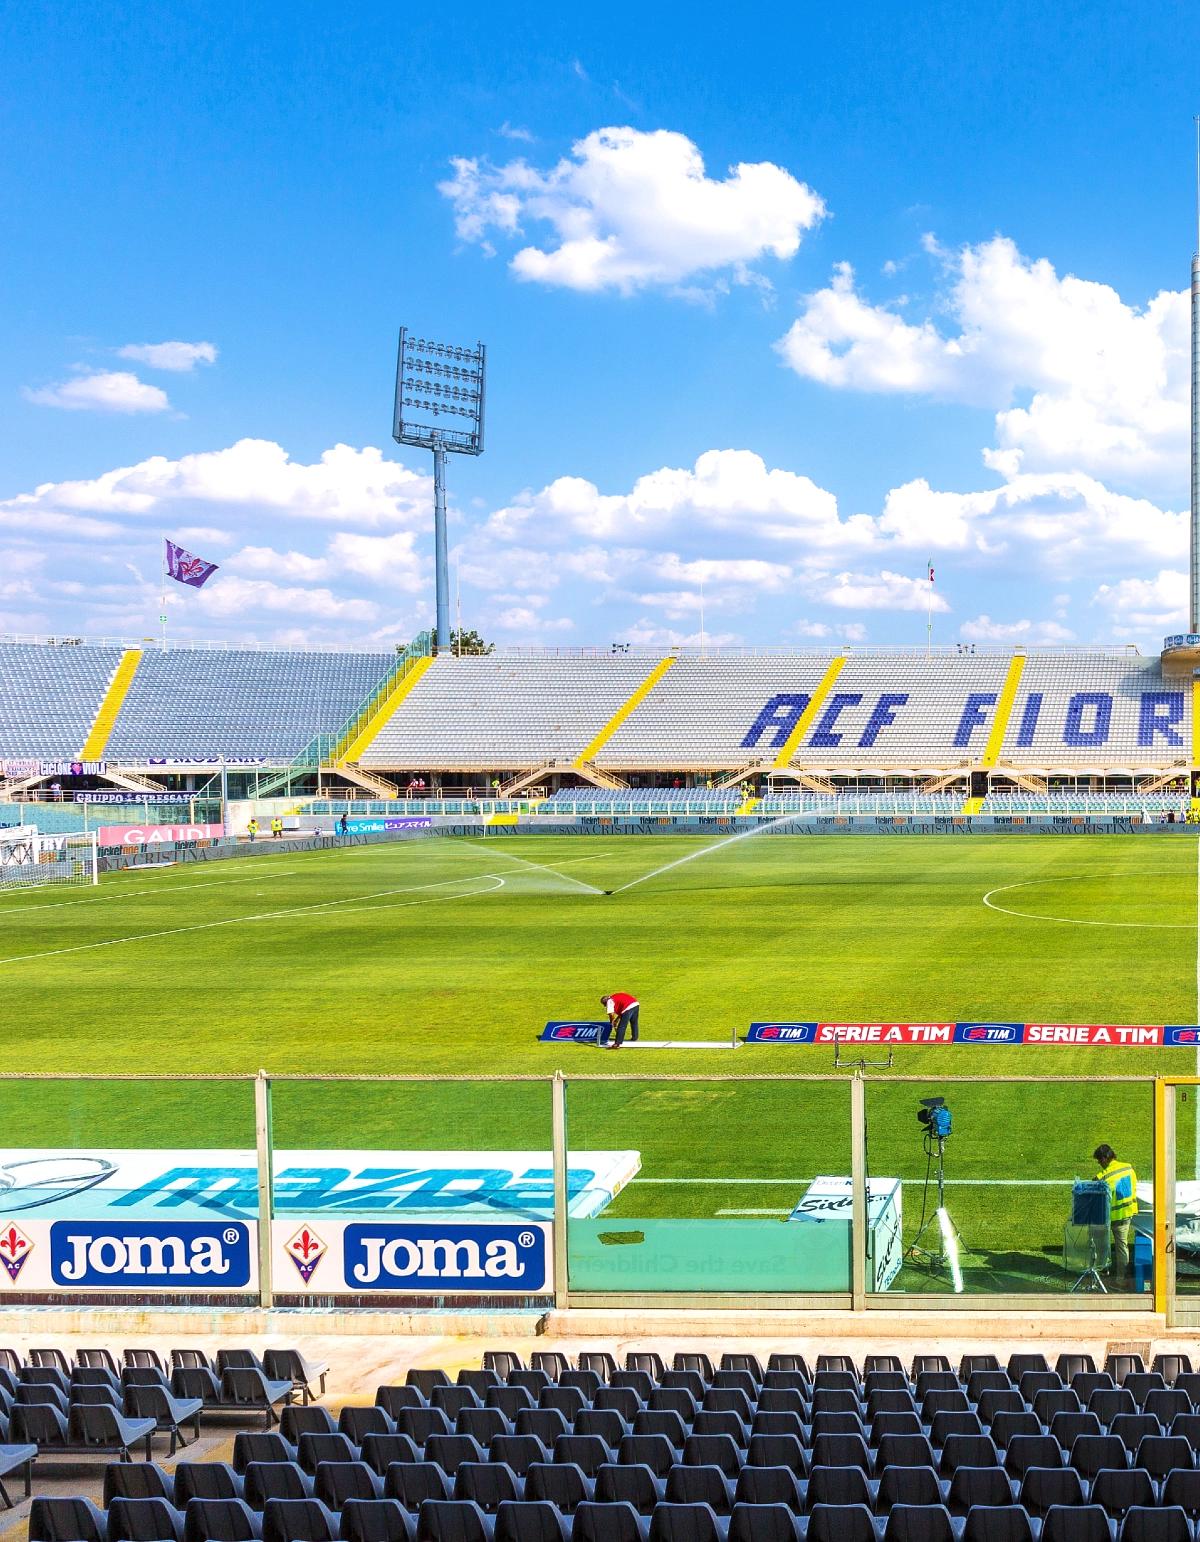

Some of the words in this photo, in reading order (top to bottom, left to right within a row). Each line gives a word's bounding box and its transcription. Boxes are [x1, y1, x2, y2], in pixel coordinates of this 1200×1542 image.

[740, 693, 909, 748] ACF
[41, 762, 72, 775] CICLONE
[83, 762, 106, 775] VIOLA
[76, 794, 122, 803] GRUPPO
[424, 827, 450, 836] SANTA
[452, 824, 518, 835] CRISTINA
[560, 826, 590, 834] SANTA
[592, 824, 653, 834] CRISTINA
[878, 826, 910, 834] SANTA
[912, 824, 973, 834] CRISTINA
[1040, 826, 1070, 834] SANTA
[1073, 824, 1135, 834] CRISTINA
[280, 842, 311, 852] SANTA
[313, 834, 368, 849] CRISTINA
[132, 848, 208, 866] CRISTINA
[572, 1027, 599, 1039] TIM
[777, 1028, 802, 1039] TIM
[820, 1026, 878, 1042] SERIE
[880, 1027, 903, 1042] A
[908, 1026, 951, 1042] TIM
[986, 1030, 1010, 1040] TIM
[1028, 1026, 1090, 1042] SERIE
[1090, 1027, 1111, 1042] A
[1118, 1028, 1158, 1043] TIM
